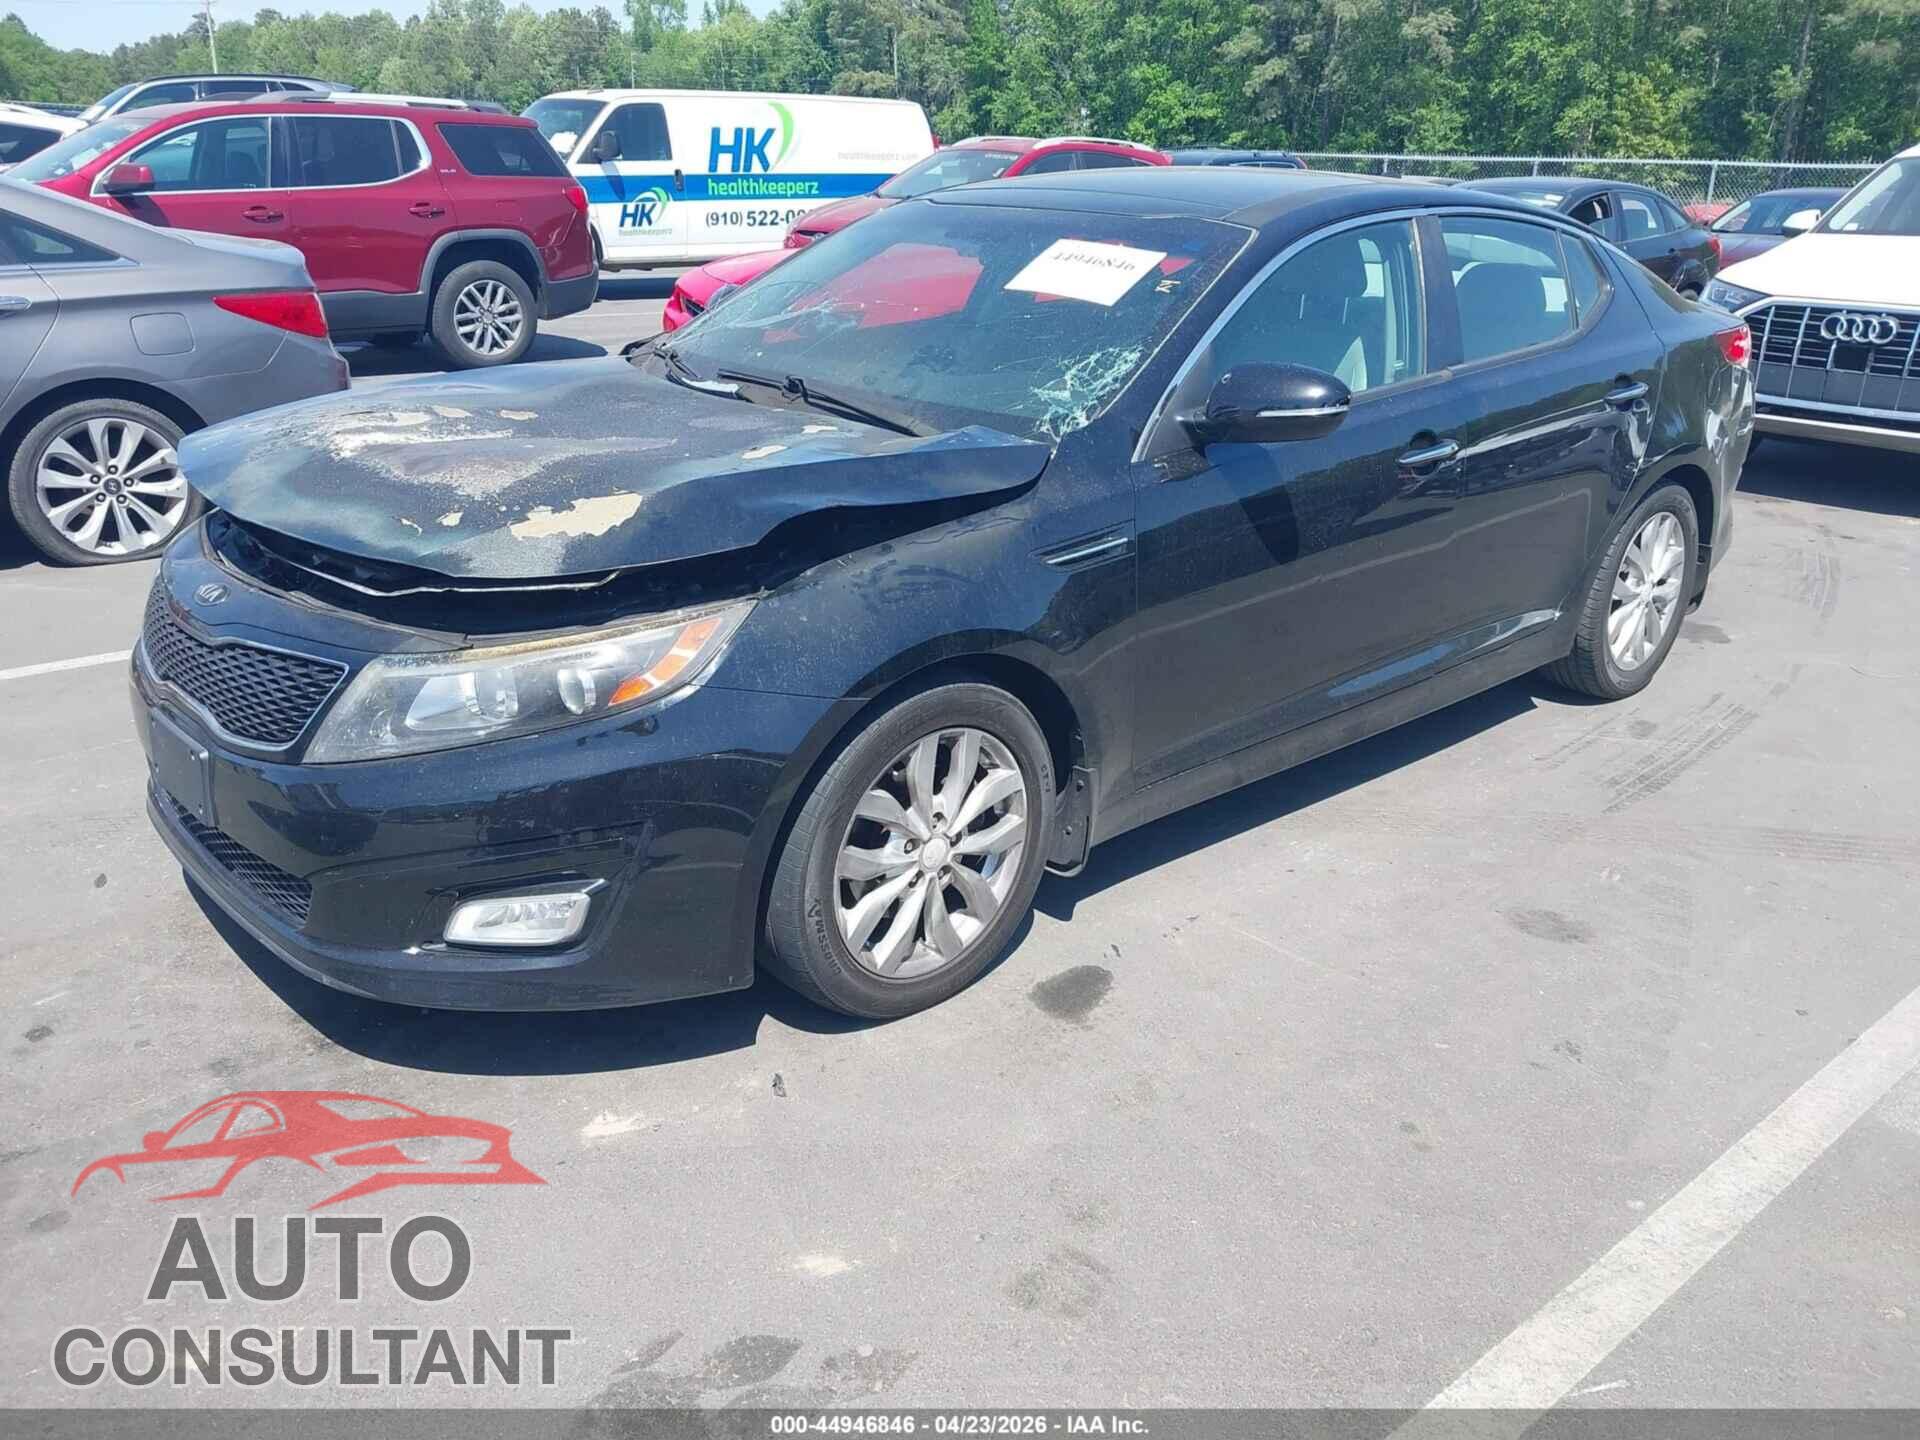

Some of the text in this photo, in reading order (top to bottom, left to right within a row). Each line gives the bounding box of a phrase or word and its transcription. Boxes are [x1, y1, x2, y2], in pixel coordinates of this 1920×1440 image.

[707, 126, 776, 173] HK
[707, 177, 820, 198] healthkeeperz
[618, 203, 657, 228] HK
[705, 211, 743, 228] (910)
